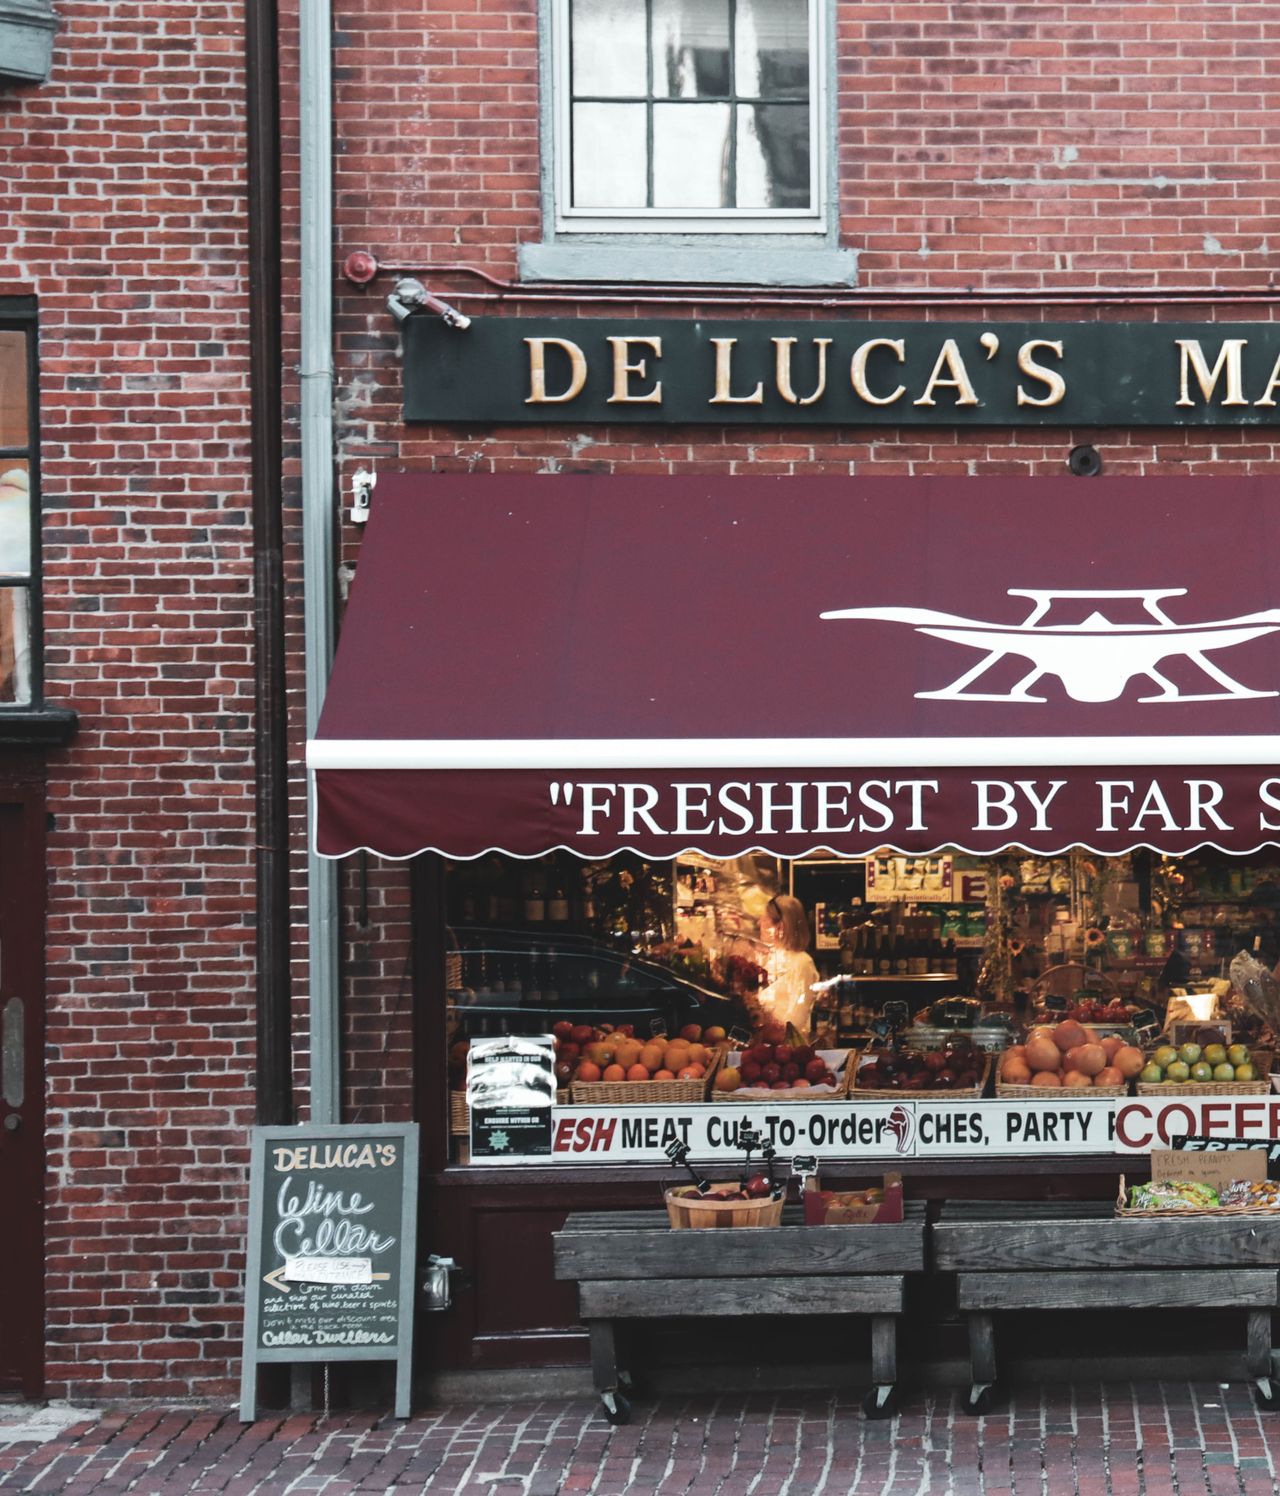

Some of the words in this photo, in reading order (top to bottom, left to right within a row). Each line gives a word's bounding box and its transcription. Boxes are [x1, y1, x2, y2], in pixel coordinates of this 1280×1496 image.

[523, 336, 662, 404] DE
[708, 331, 1065, 406] LUCA'S
[549, 780, 939, 836] "FRESHEST
[971, 781, 1068, 832] BY
[1095, 779, 1234, 832] FAR
[552, 1118, 618, 1153] ESH
[622, 1117, 693, 1149] MEAT
[1006, 1111, 1093, 1142] PARTY
[273, 1144, 397, 1172] DELUCA'S
[277, 1176, 375, 1218] Wine
[273, 1217, 396, 1259] Cellar
[299, 1283, 327, 1294] Come
[332, 1284, 347, 1292] on
[351, 1283, 383, 1292] down
[330, 1291, 375, 1300] curated
[309, 1301, 320, 1312] of
[262, 1330, 313, 1347] Cellar
[312, 1329, 395, 1345] Dwellers
